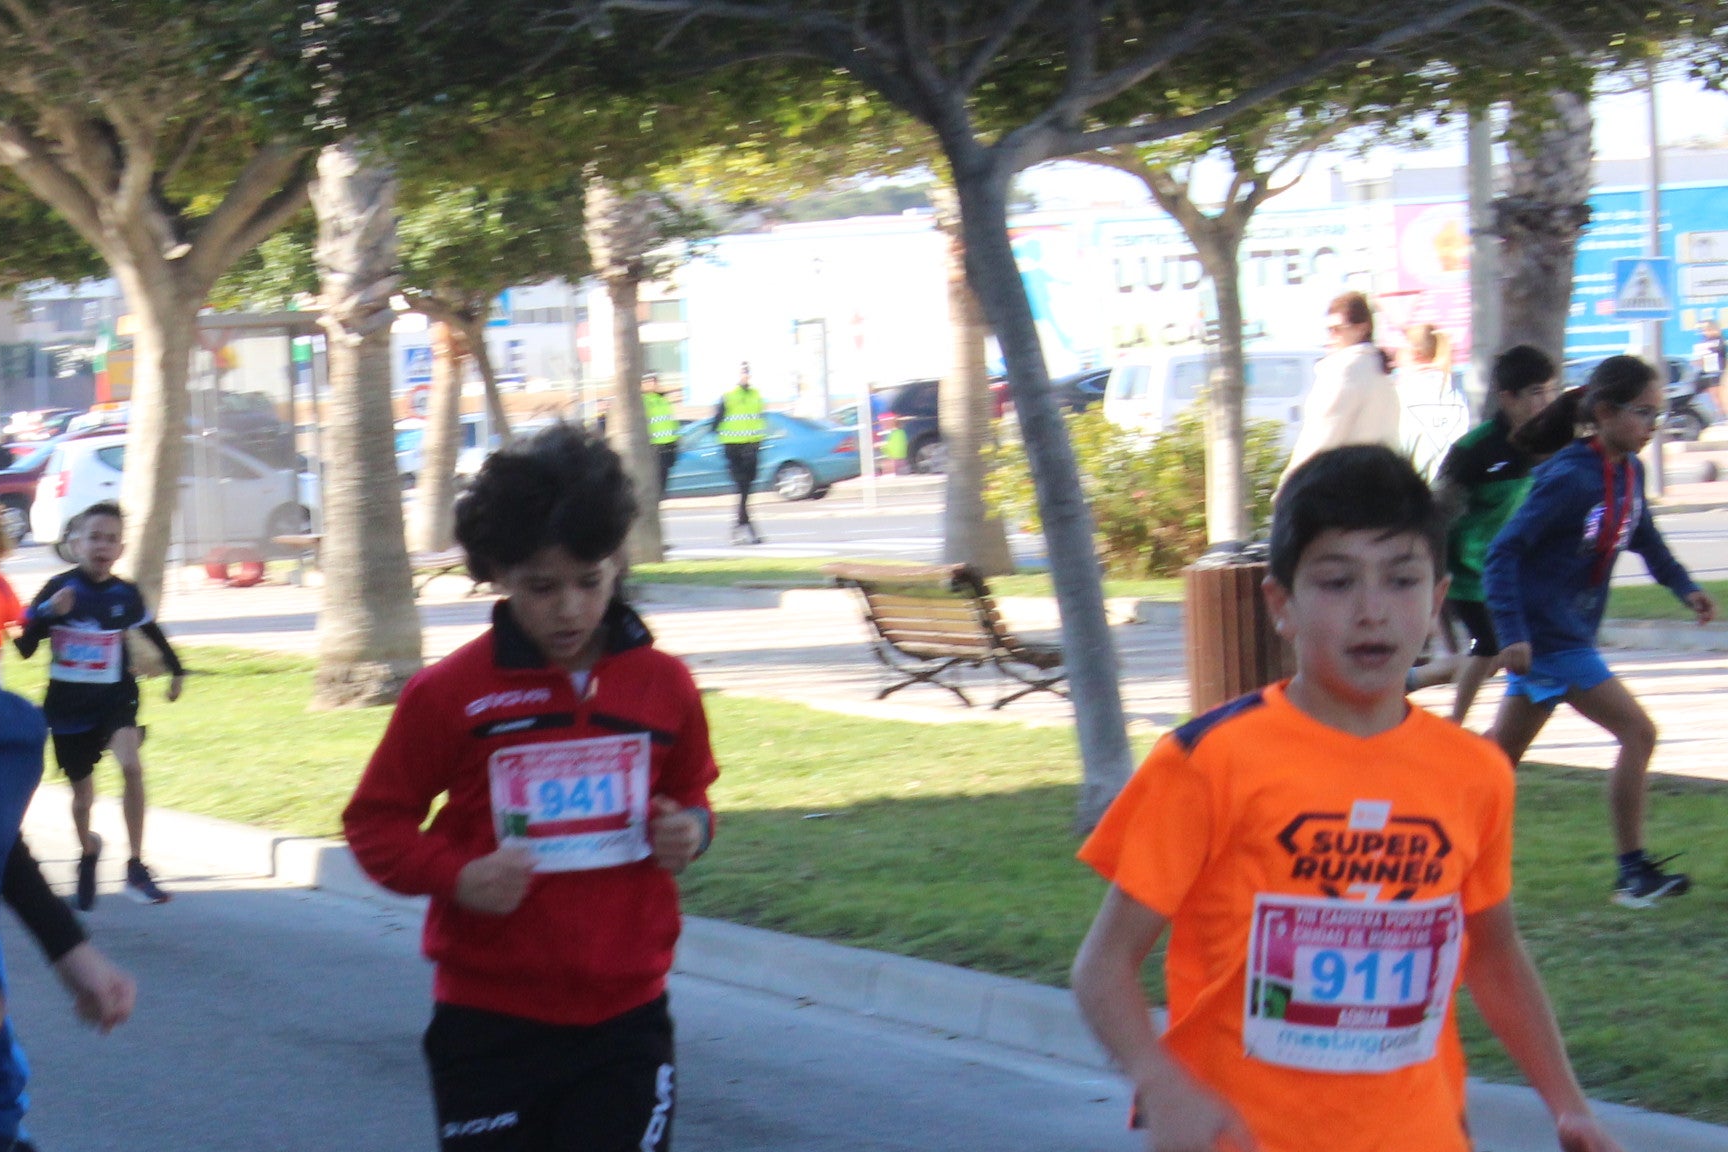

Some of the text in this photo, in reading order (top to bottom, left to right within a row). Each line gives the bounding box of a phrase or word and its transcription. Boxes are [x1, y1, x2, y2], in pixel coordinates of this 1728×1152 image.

[539, 774, 614, 818] 941
[1311, 831, 1429, 858] SUPER
[1291, 856, 1444, 884] RUNNER
[1311, 949, 1415, 1000] 911
